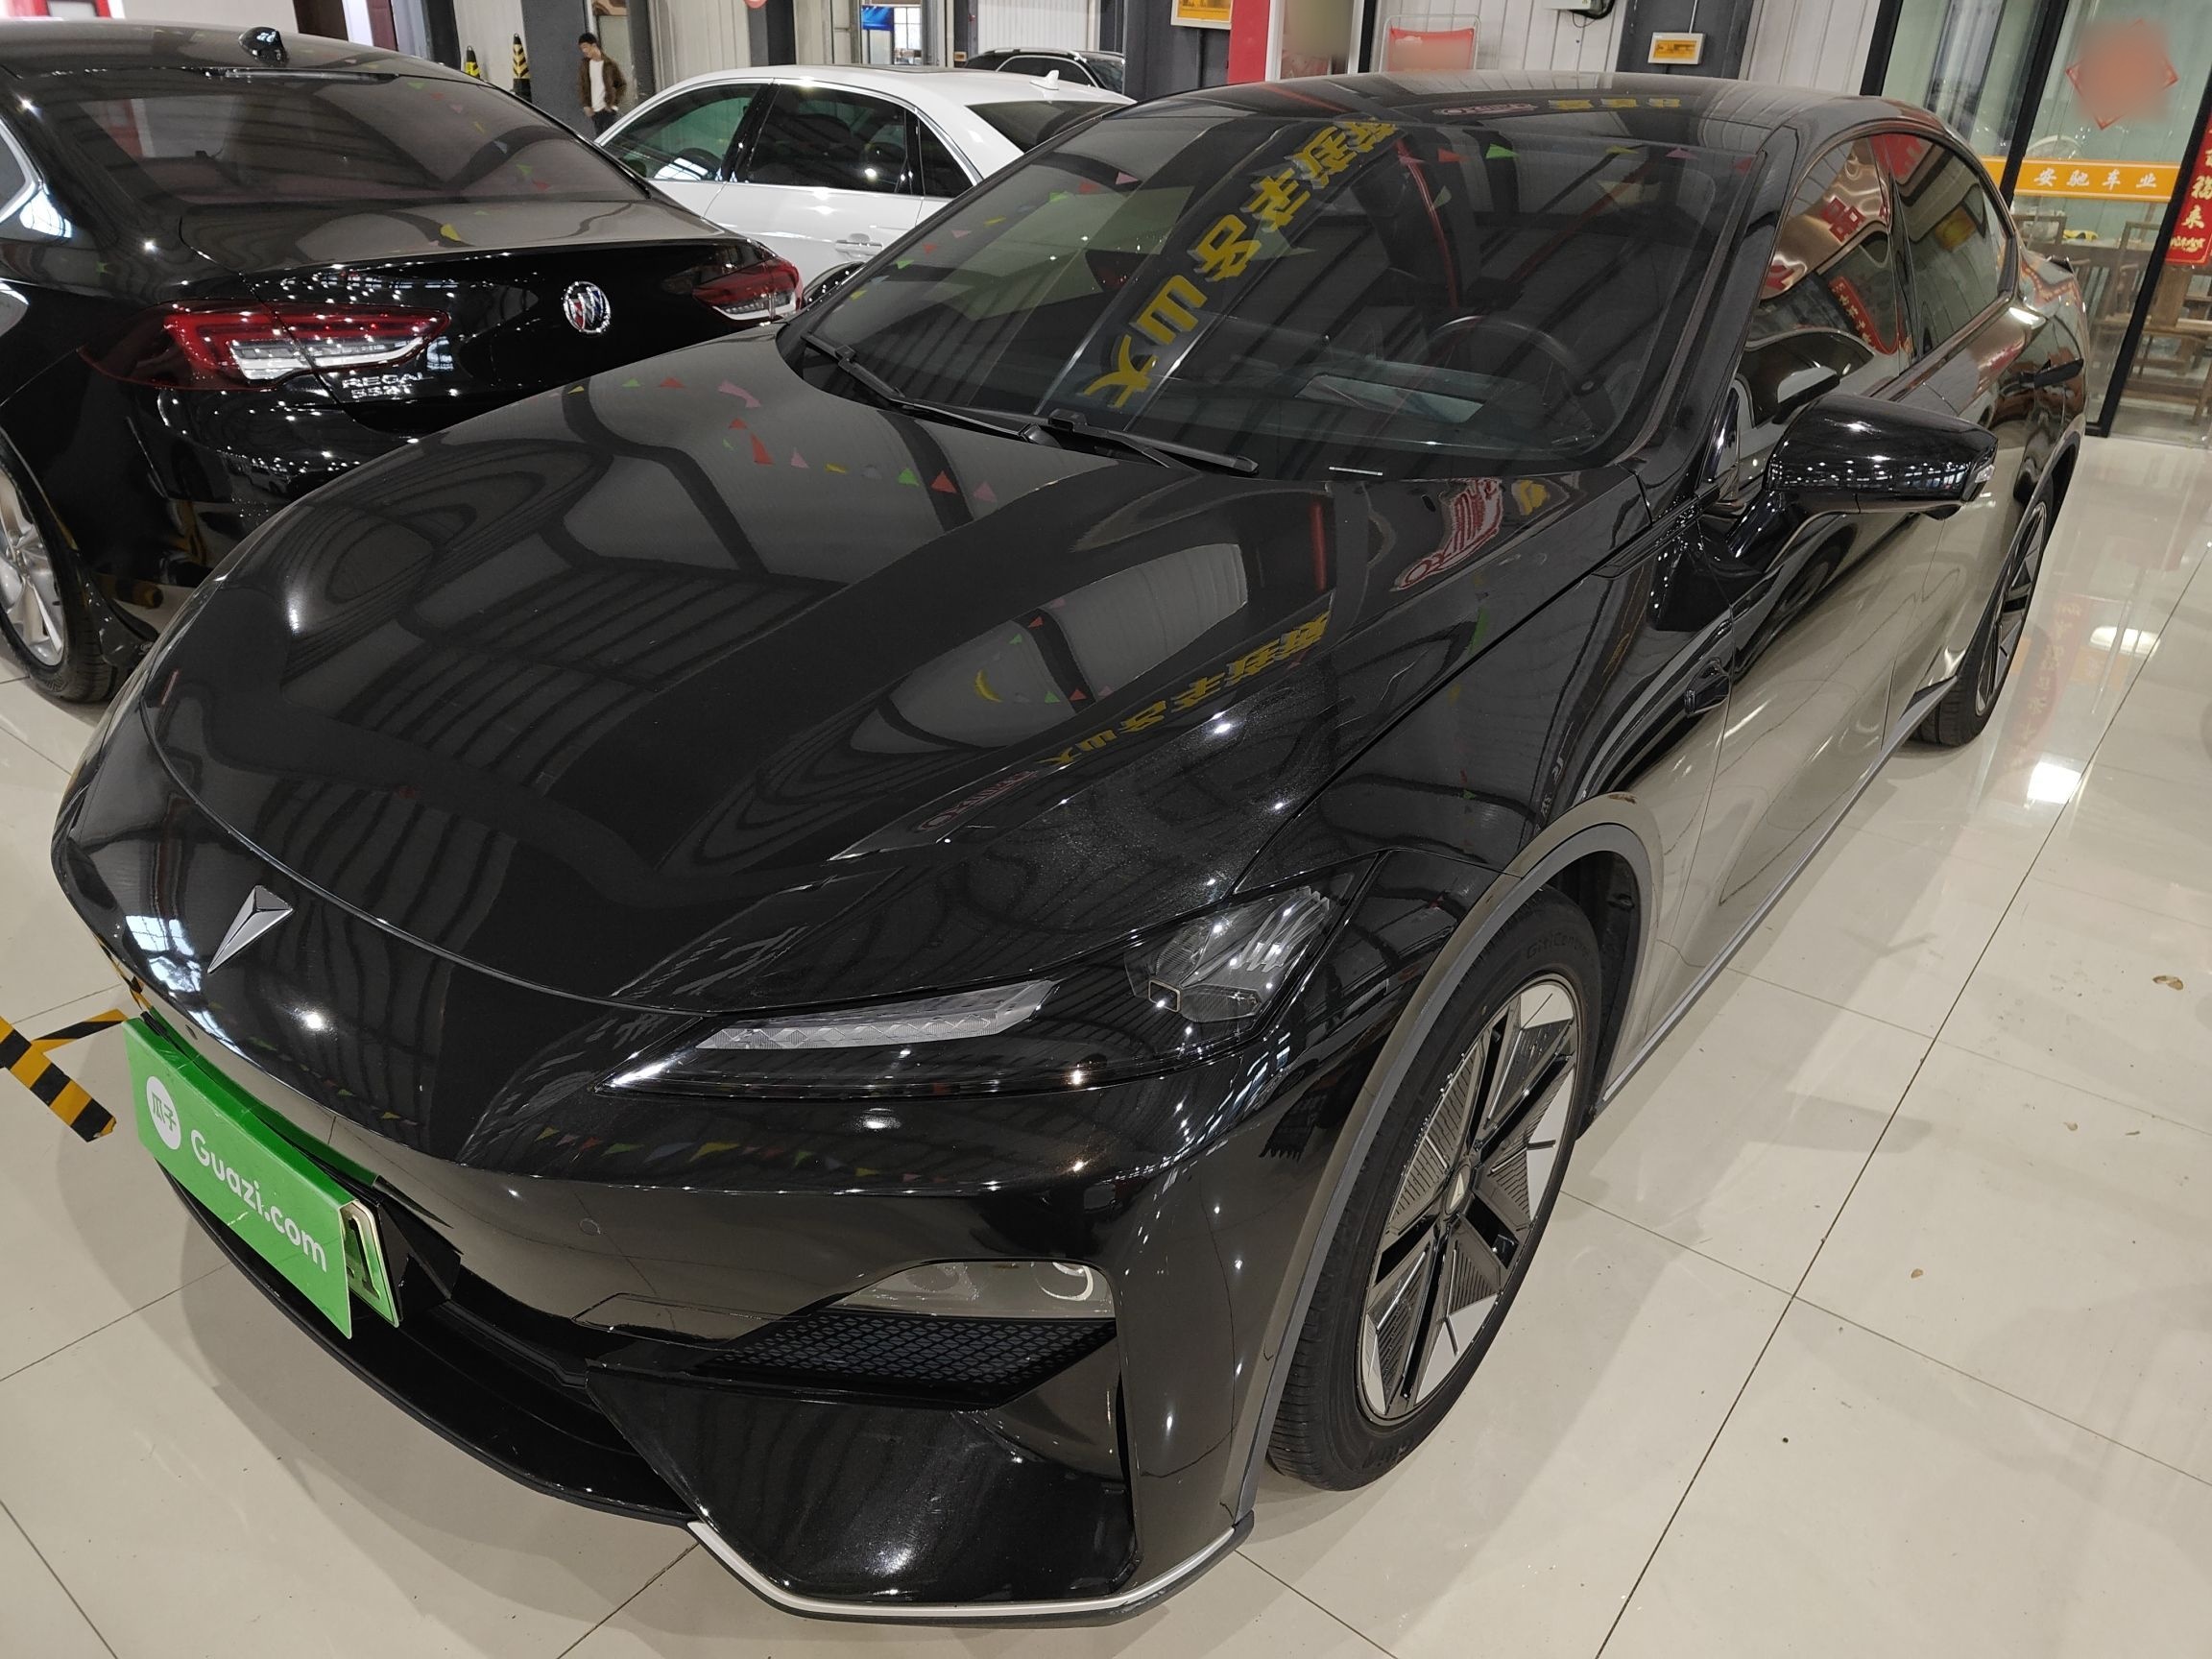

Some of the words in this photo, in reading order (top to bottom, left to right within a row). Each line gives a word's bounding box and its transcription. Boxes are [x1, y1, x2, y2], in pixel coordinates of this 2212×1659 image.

[2032, 167, 2157, 191] 安驰车业
[151, 1091, 178, 1132] 瓜子
[191, 1129, 327, 1273] Guazi.com
